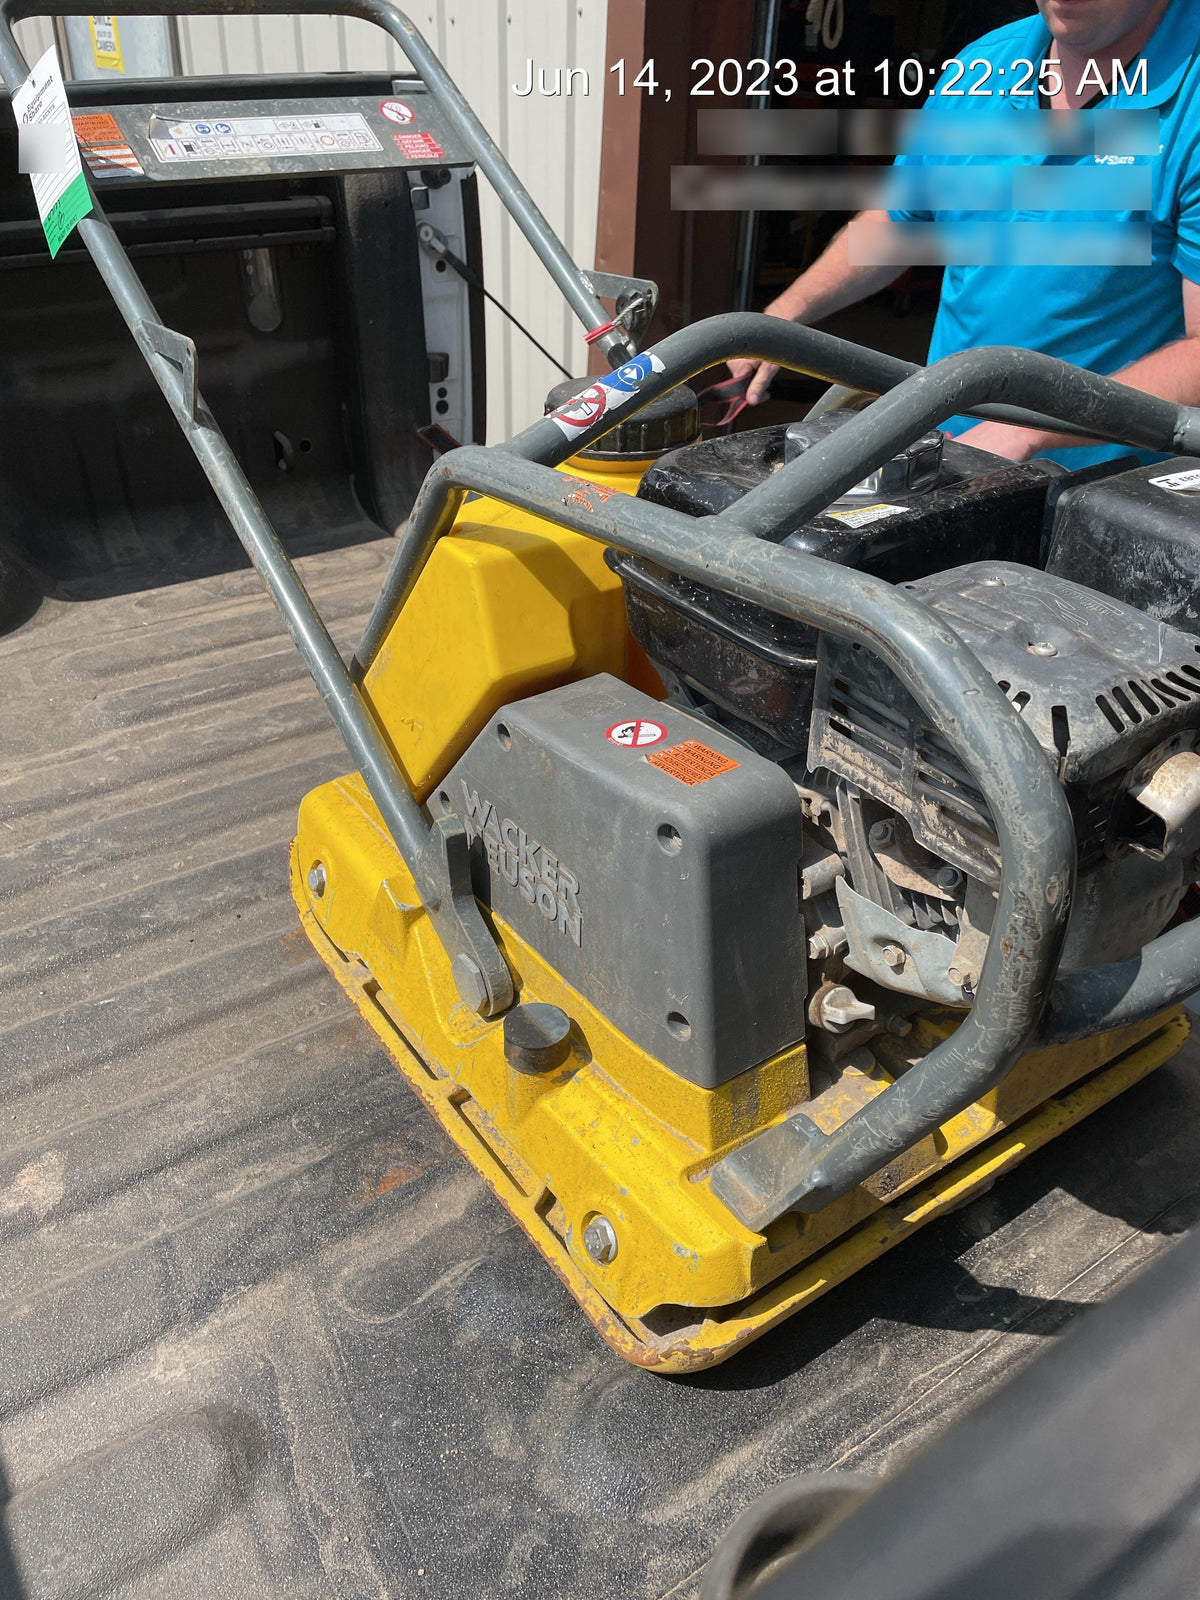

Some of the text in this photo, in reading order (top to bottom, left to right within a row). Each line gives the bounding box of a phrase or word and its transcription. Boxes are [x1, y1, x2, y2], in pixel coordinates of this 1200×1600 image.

[26, 75, 54, 113] Equipment
[28, 100, 43, 122] Share
[683, 748, 722, 769] WARNUNG
[693, 744, 729, 764] WARNING
[653, 760, 696, 786] AVVERTENZA
[460, 778, 582, 915] WACKER
[463, 814, 584, 948] NEUSON
